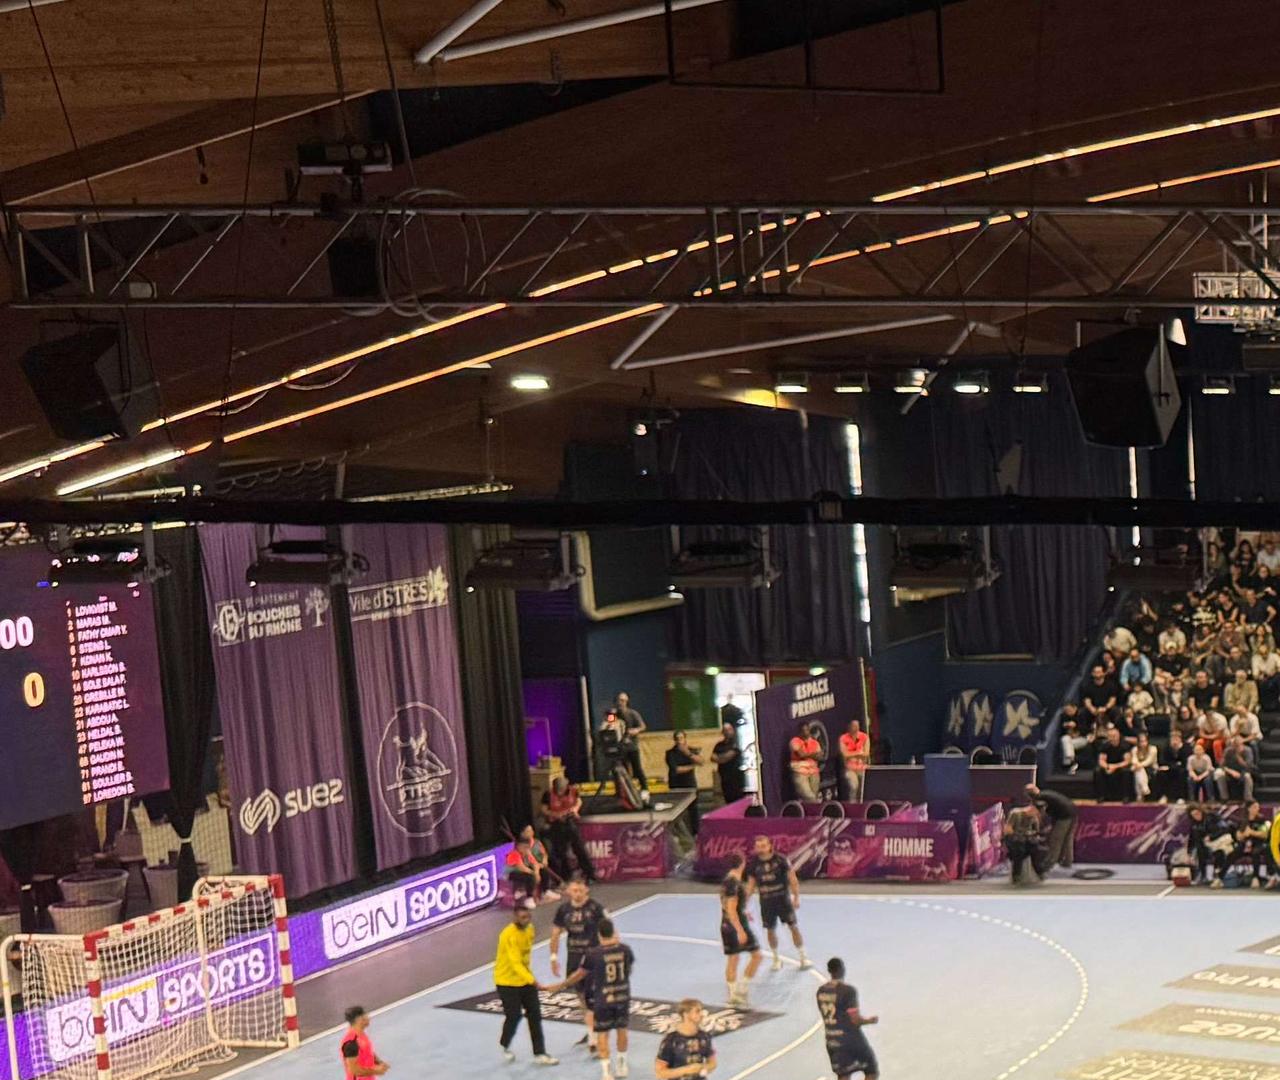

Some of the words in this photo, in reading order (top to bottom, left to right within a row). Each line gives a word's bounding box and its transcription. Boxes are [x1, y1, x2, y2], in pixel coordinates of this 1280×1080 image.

[24, 672, 44, 708] 0
[791, 693, 835, 719] PREMIUM
[795, 677, 829, 700] ESPACE
[285, 778, 344, 818] suez
[884, 838, 934, 857] HOMME
[330, 907, 398, 949] beIN
[409, 867, 492, 922] SPORTS
[162, 947, 266, 1013] SPORTS
